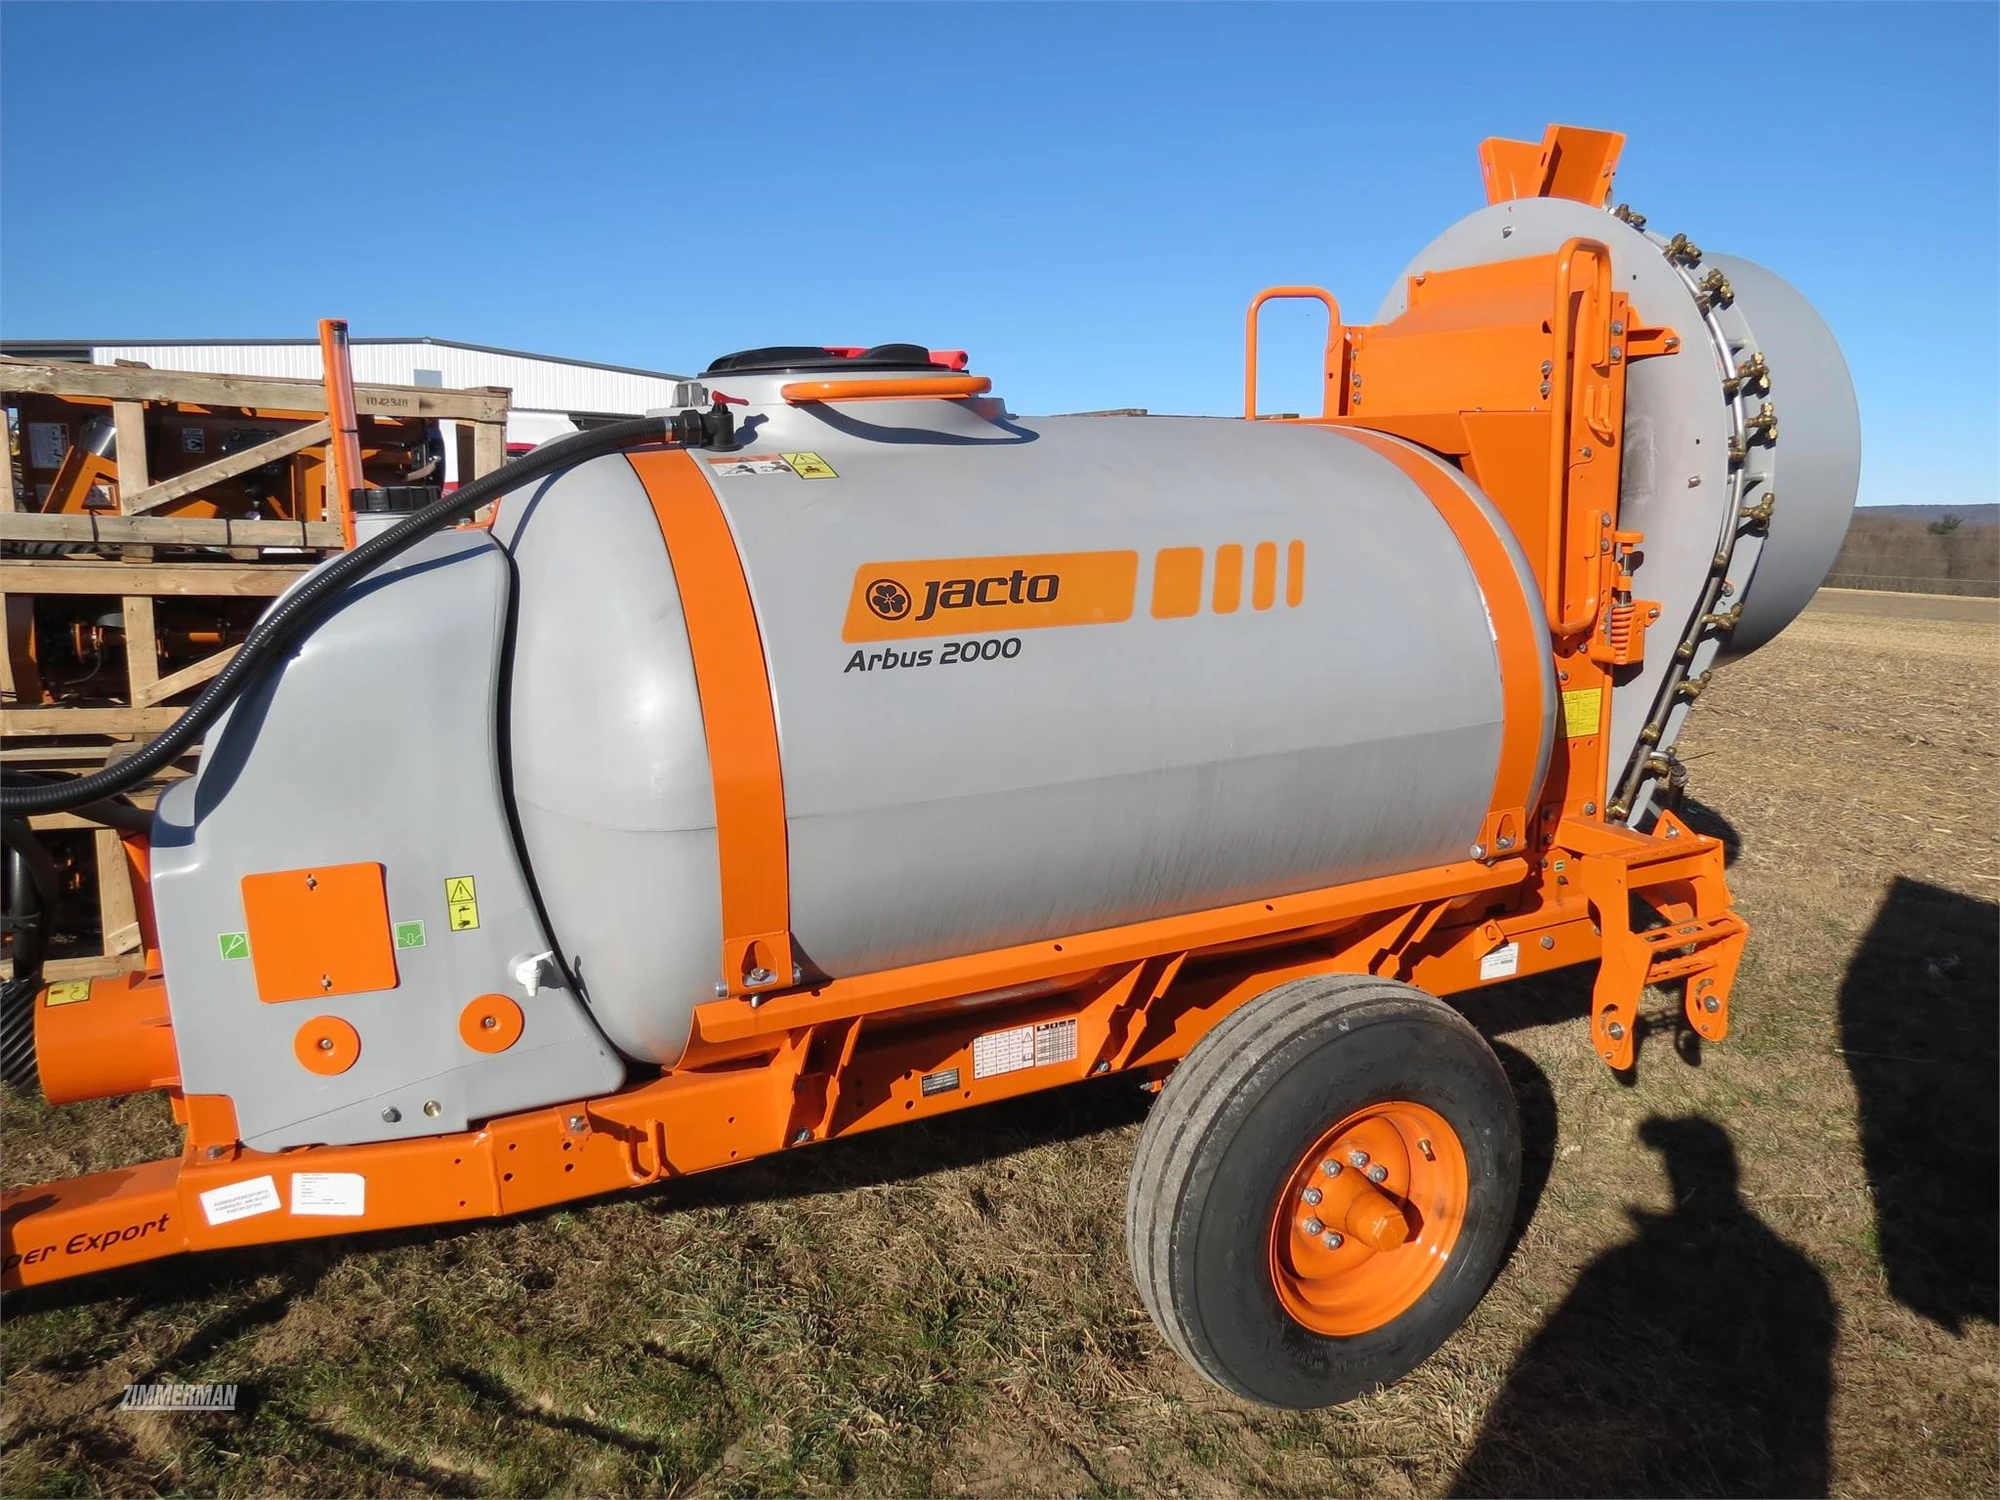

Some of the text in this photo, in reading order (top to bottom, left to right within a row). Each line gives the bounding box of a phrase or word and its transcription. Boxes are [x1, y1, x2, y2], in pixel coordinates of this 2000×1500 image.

[915, 570, 1060, 622] jacto
[843, 637, 1023, 674] Arbus 2000
[65, 1213, 171, 1255] Export
